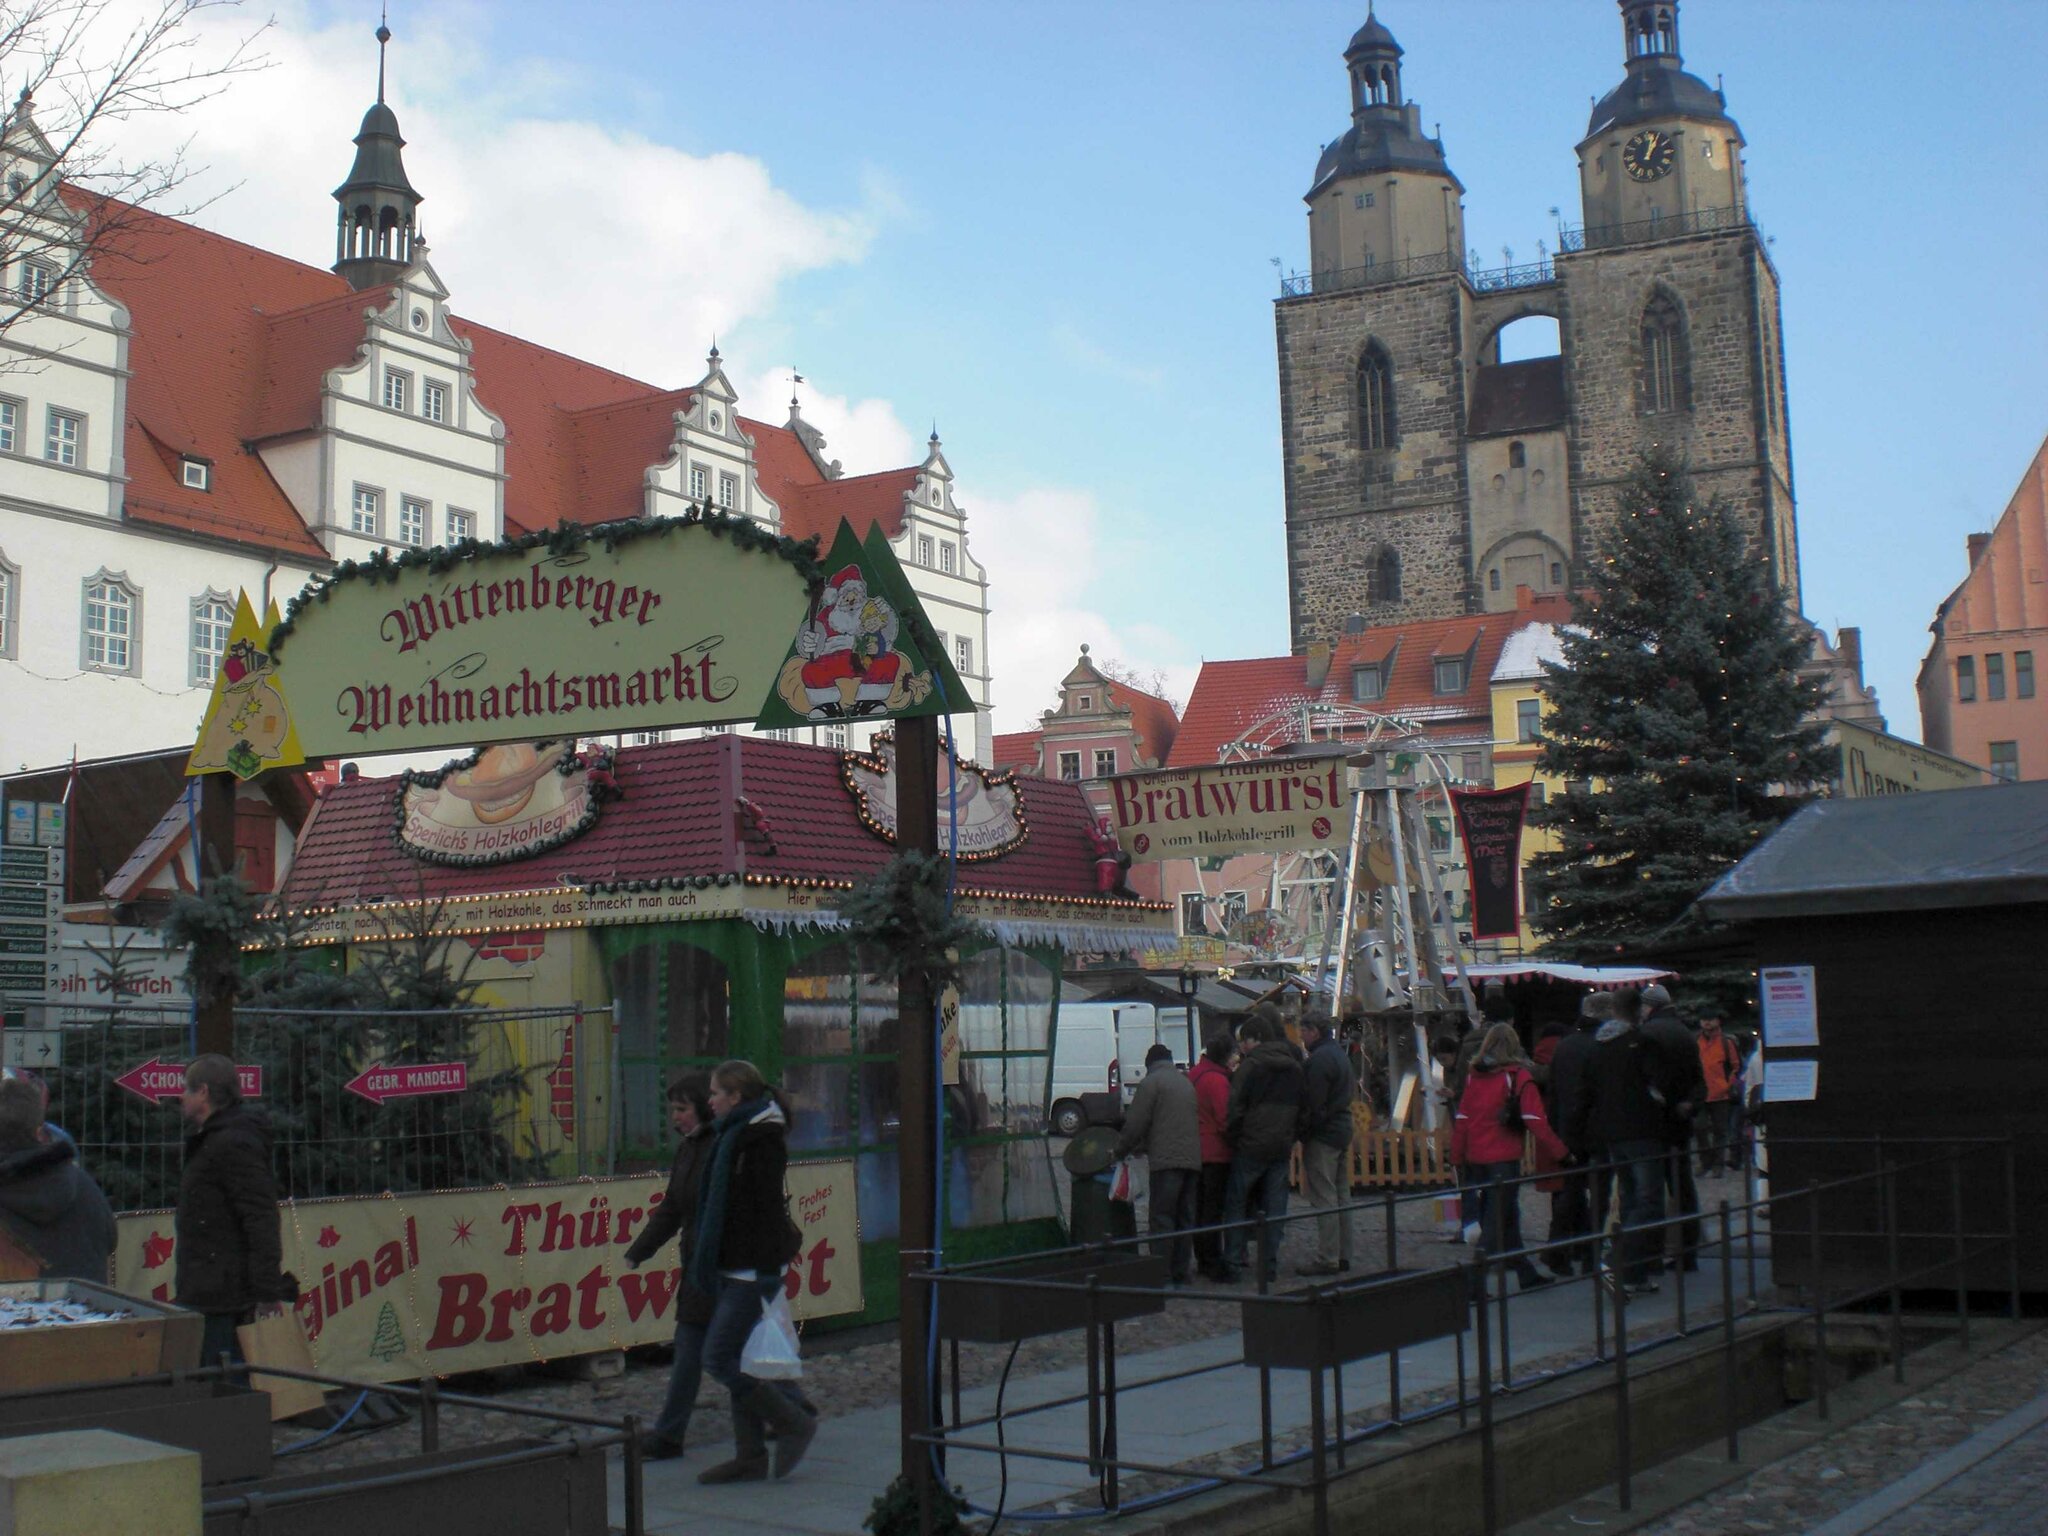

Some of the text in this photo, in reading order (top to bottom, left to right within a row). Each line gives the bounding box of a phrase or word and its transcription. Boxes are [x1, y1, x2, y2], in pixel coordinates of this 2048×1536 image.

[380, 552, 662, 654] Wittenberger
[337, 636, 739, 735] Weihnachtsmarkt
[1112, 760, 1345, 829] Bratwurst
[474, 796, 585, 850] Holzkohlegrill
[938, 814, 1019, 847] Hlzkohlegrill
[1161, 825, 1295, 847] vom Holzkohlegrill
[466, 908, 484, 920] mit
[552, 900, 572, 914] das
[577, 894, 632, 911] schmeckt
[638, 895, 663, 908] man
[668, 891, 696, 906] auch
[788, 891, 811, 905] Hier
[953, 903, 980, 915] rauch
[367, 1068, 461, 1090] GEBR. MANDELN
[799, 1183, 832, 1213] Frohes
[804, 1204, 826, 1228] Fest
